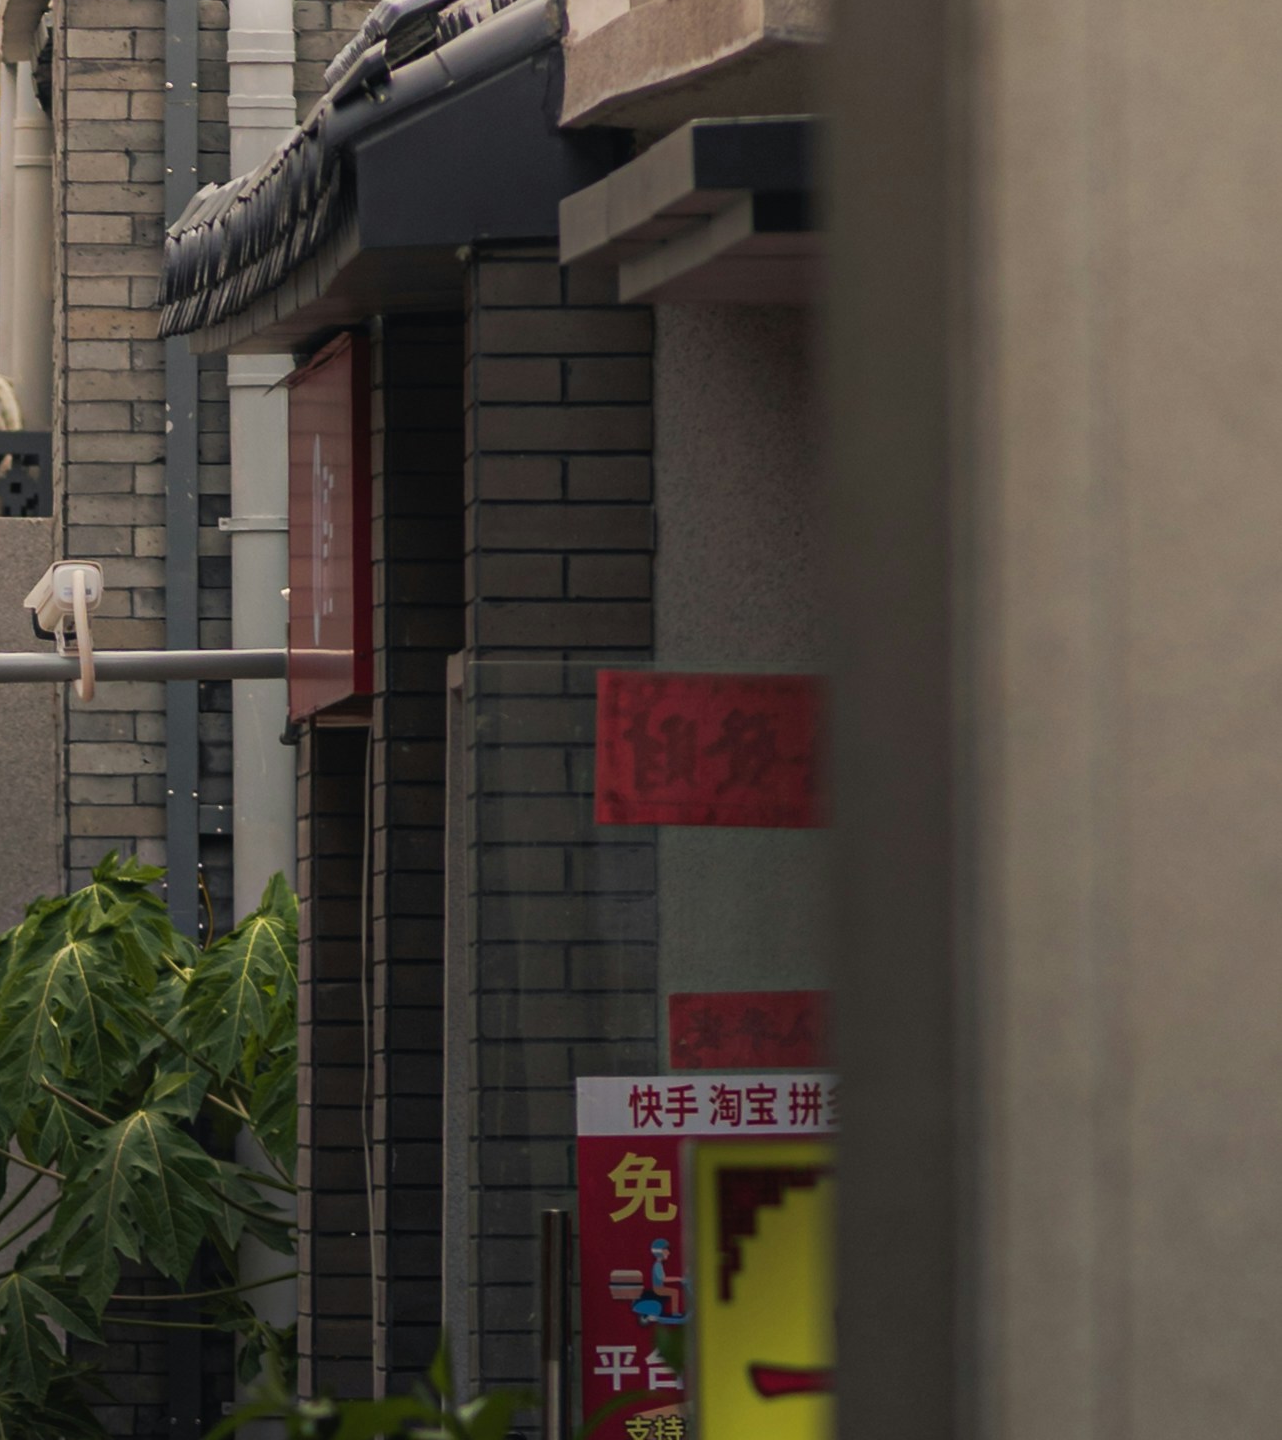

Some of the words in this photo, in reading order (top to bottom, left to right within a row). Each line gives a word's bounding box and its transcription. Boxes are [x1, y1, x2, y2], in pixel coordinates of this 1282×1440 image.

[629, 1083, 699, 1128] 快手
[709, 1082, 779, 1127] 淘宝
[608, 1151, 678, 1222] 免
[593, 1344, 685, 1392] 平台
